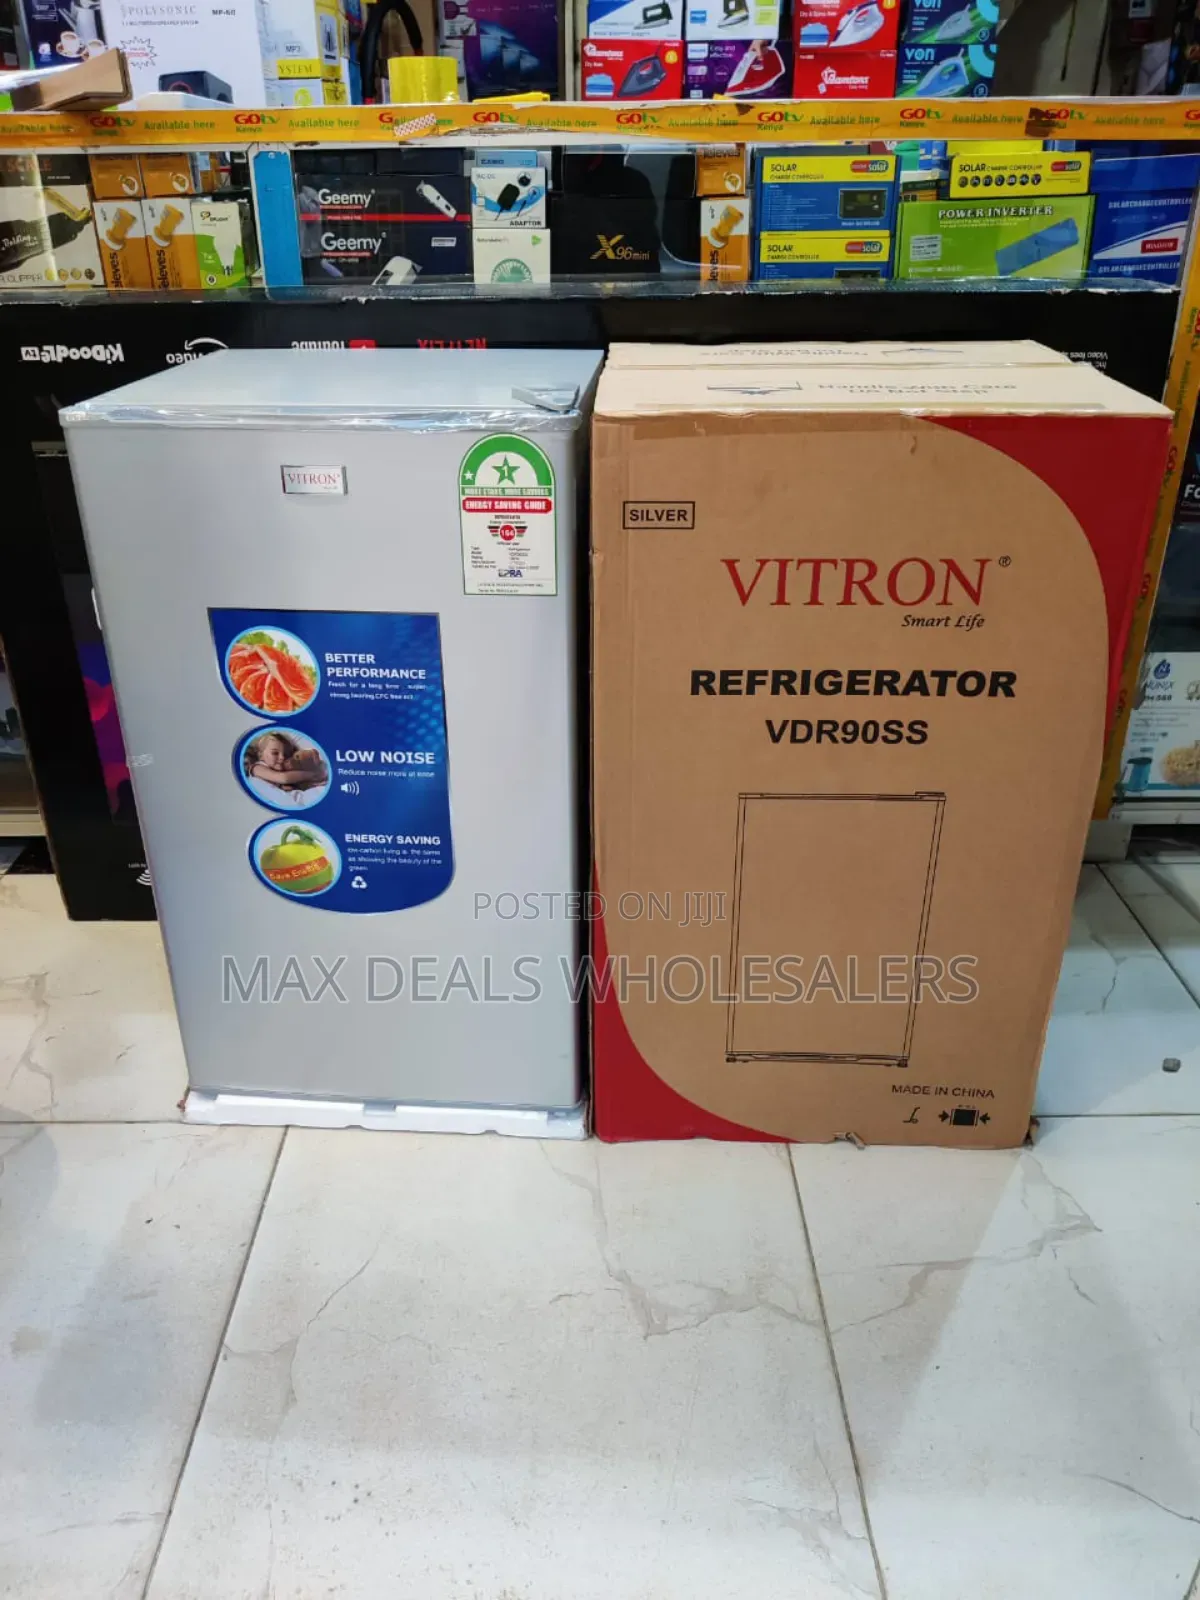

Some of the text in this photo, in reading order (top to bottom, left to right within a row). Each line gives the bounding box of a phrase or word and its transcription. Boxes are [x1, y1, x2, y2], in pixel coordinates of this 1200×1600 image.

[905, 48, 935, 60] von
[144, 120, 215, 130] Available here
[288, 120, 334, 128] Available
[810, 114, 880, 125] Available here
[959, 164, 986, 172] SOLAR
[319, 189, 371, 209] Geemy
[938, 206, 1053, 218] POWER INVERTER
[321, 232, 382, 254] Geemy
[501, 465, 508, 478] 1
[286, 473, 336, 485] VITRON
[465, 500, 546, 510] ENERGY SAVING GUIDE
[629, 509, 688, 523] SILVER
[720, 556, 992, 607] VITRON
[901, 614, 985, 632] Smart Life
[325, 653, 376, 664] BETTER
[327, 667, 426, 680] PERFORMANCE
[368, 682, 383, 690] long
[690, 669, 1017, 698] REFRIGERATOR
[765, 719, 929, 745] VDR90SS
[336, 750, 435, 765] LOW NOISE
[345, 834, 440, 845] ENERGY SAVING
[891, 1085, 995, 1098] MADE IN CHINA
